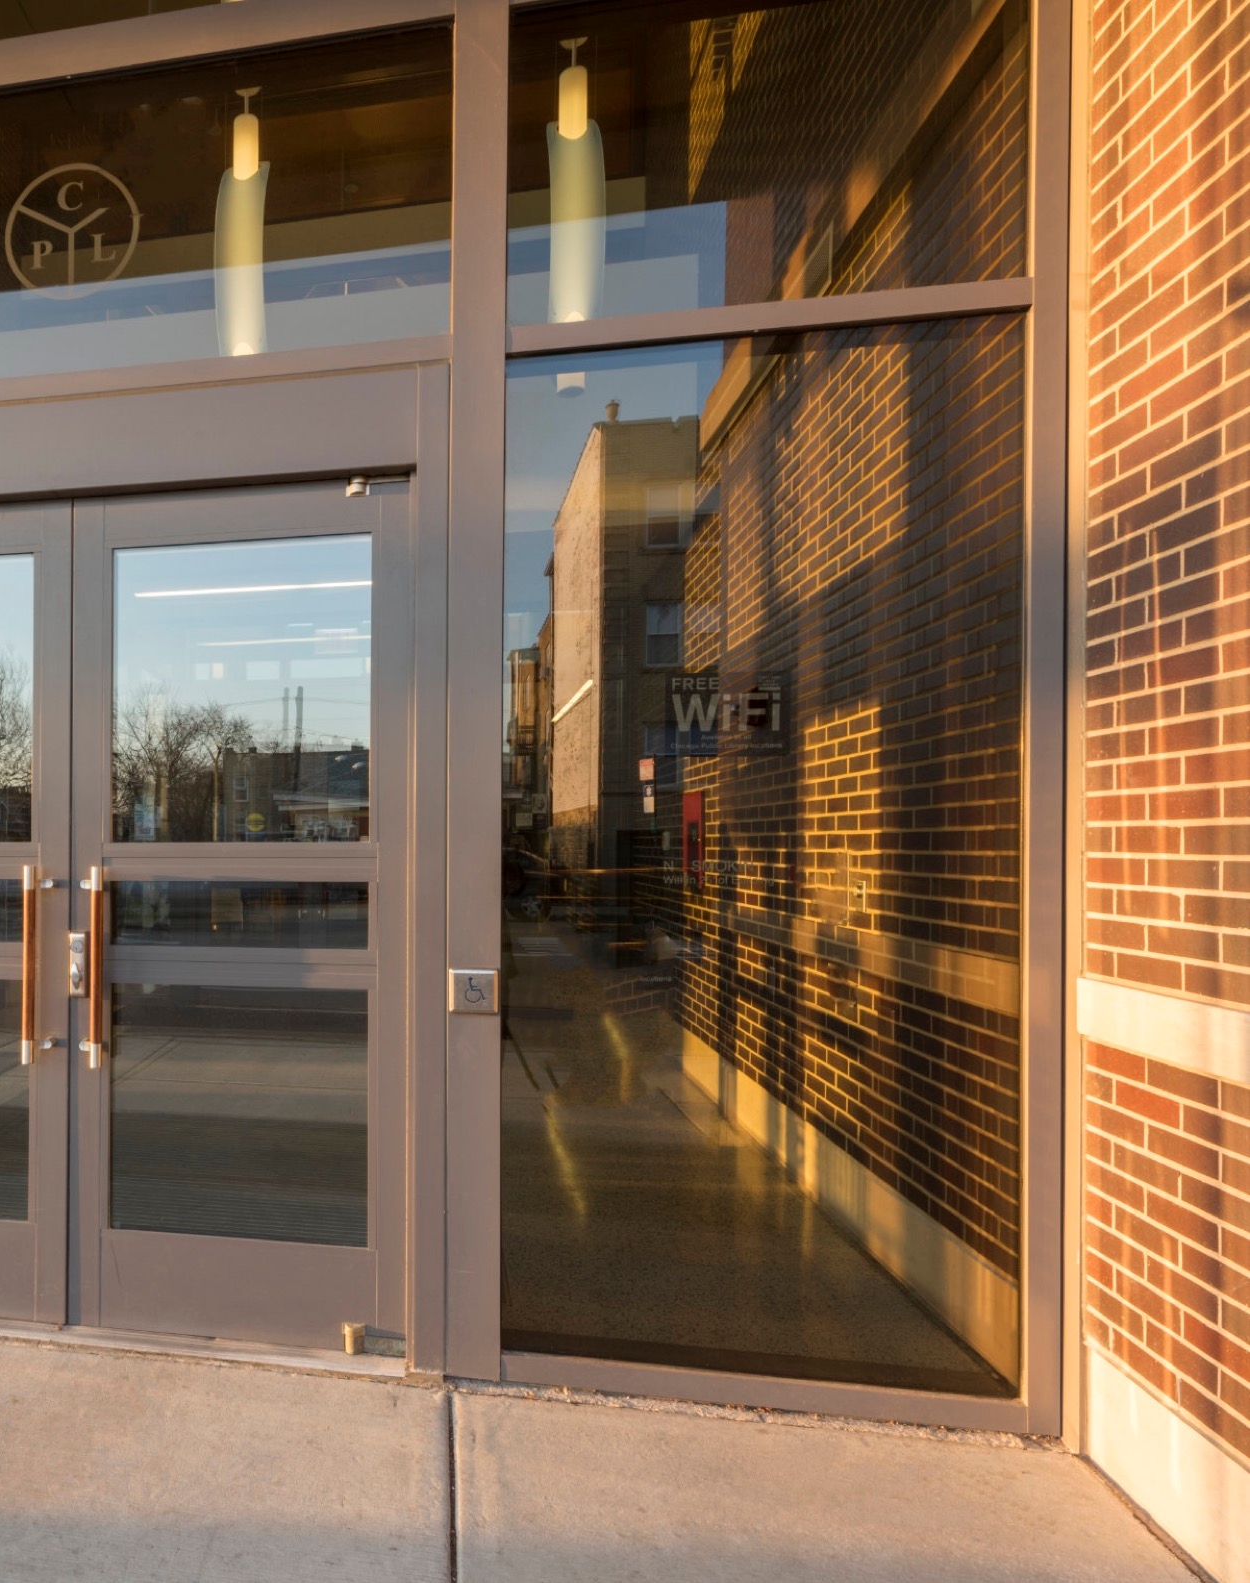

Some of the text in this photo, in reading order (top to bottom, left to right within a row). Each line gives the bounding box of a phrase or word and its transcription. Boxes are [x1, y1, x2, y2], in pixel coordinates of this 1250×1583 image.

[57, 181, 84, 211] C
[30, 233, 116, 270] P L
[672, 677, 720, 690] FREE
[672, 692, 781, 732] WiFi
[691, 860, 759, 872] SMOKIN
